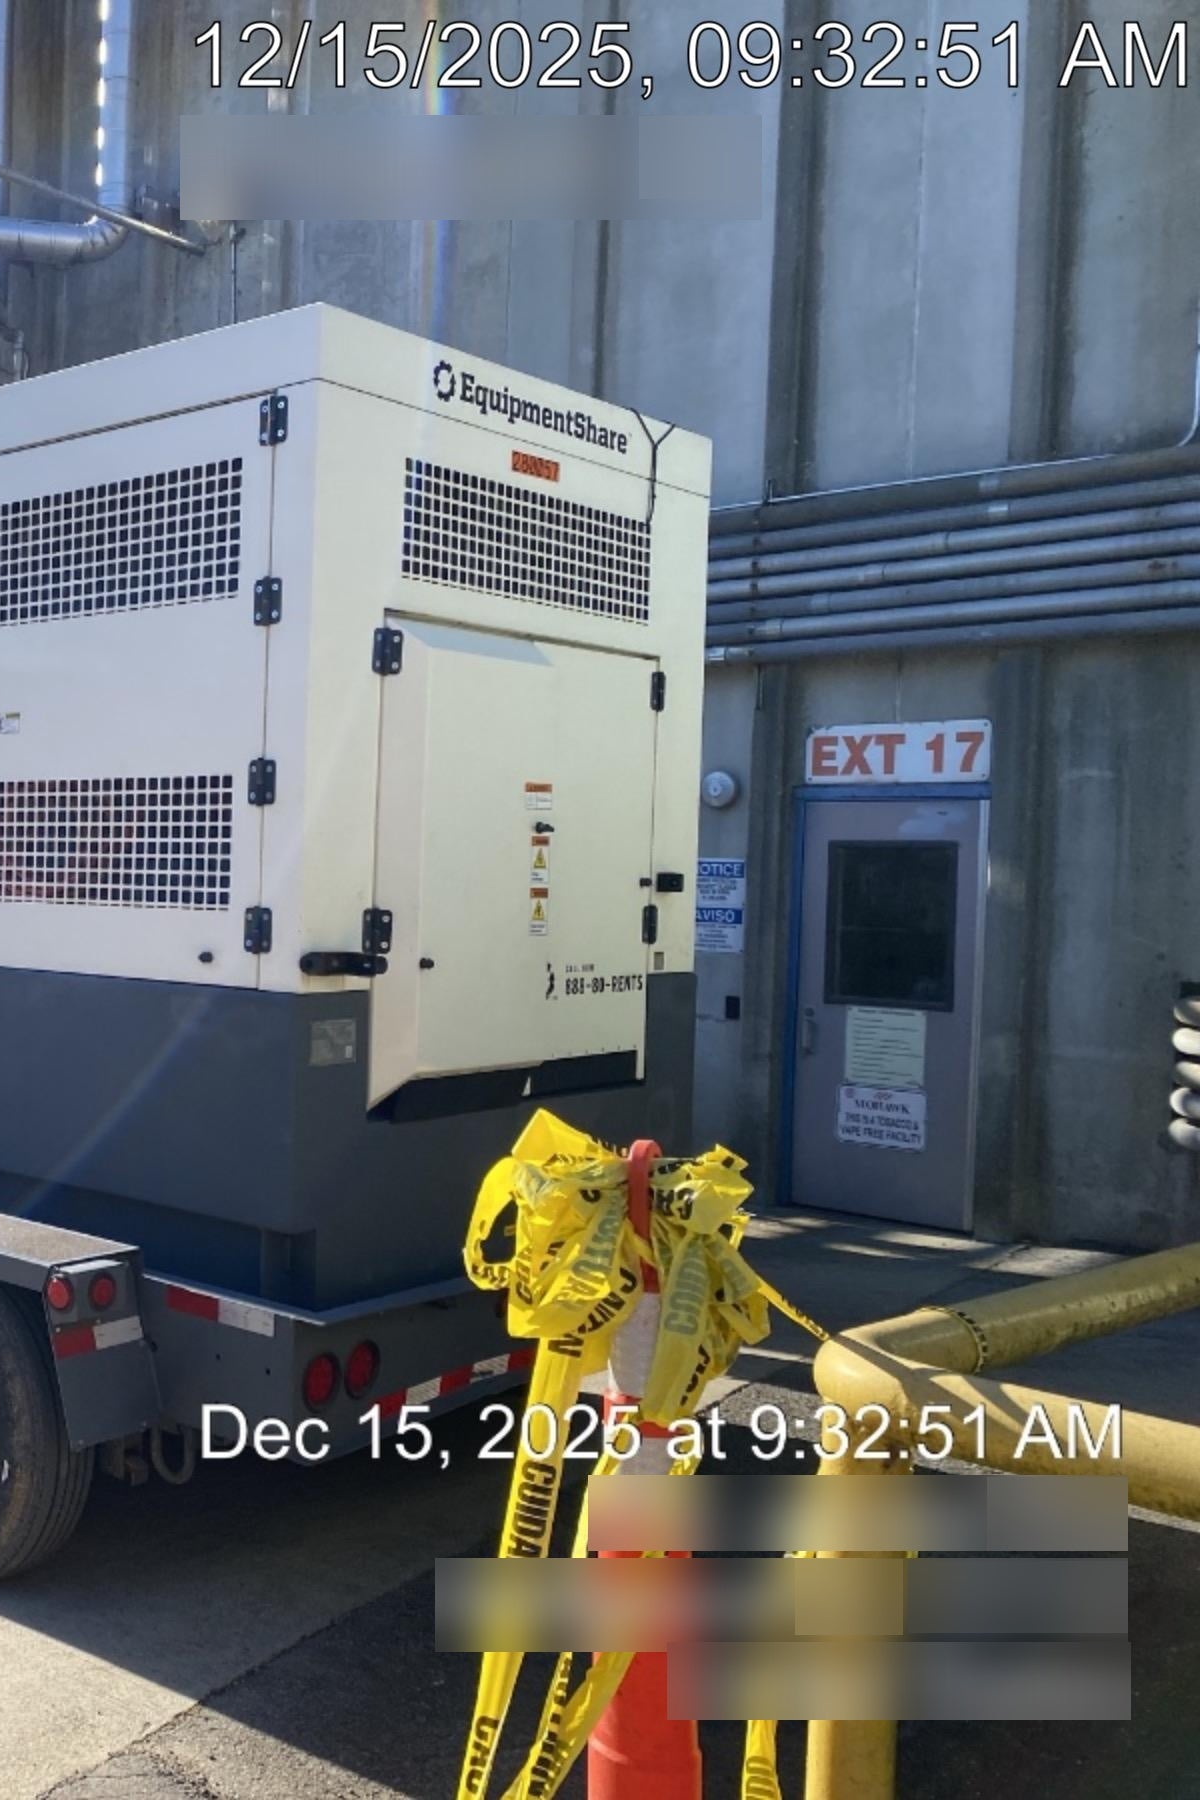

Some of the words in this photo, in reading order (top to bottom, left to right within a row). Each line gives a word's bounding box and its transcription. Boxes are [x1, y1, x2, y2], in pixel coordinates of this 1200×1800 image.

[460, 372, 628, 455] EquipmentShare
[811, 733, 906, 777] EXT
[925, 731, 985, 774] 17
[698, 862, 743, 877] OTICE
